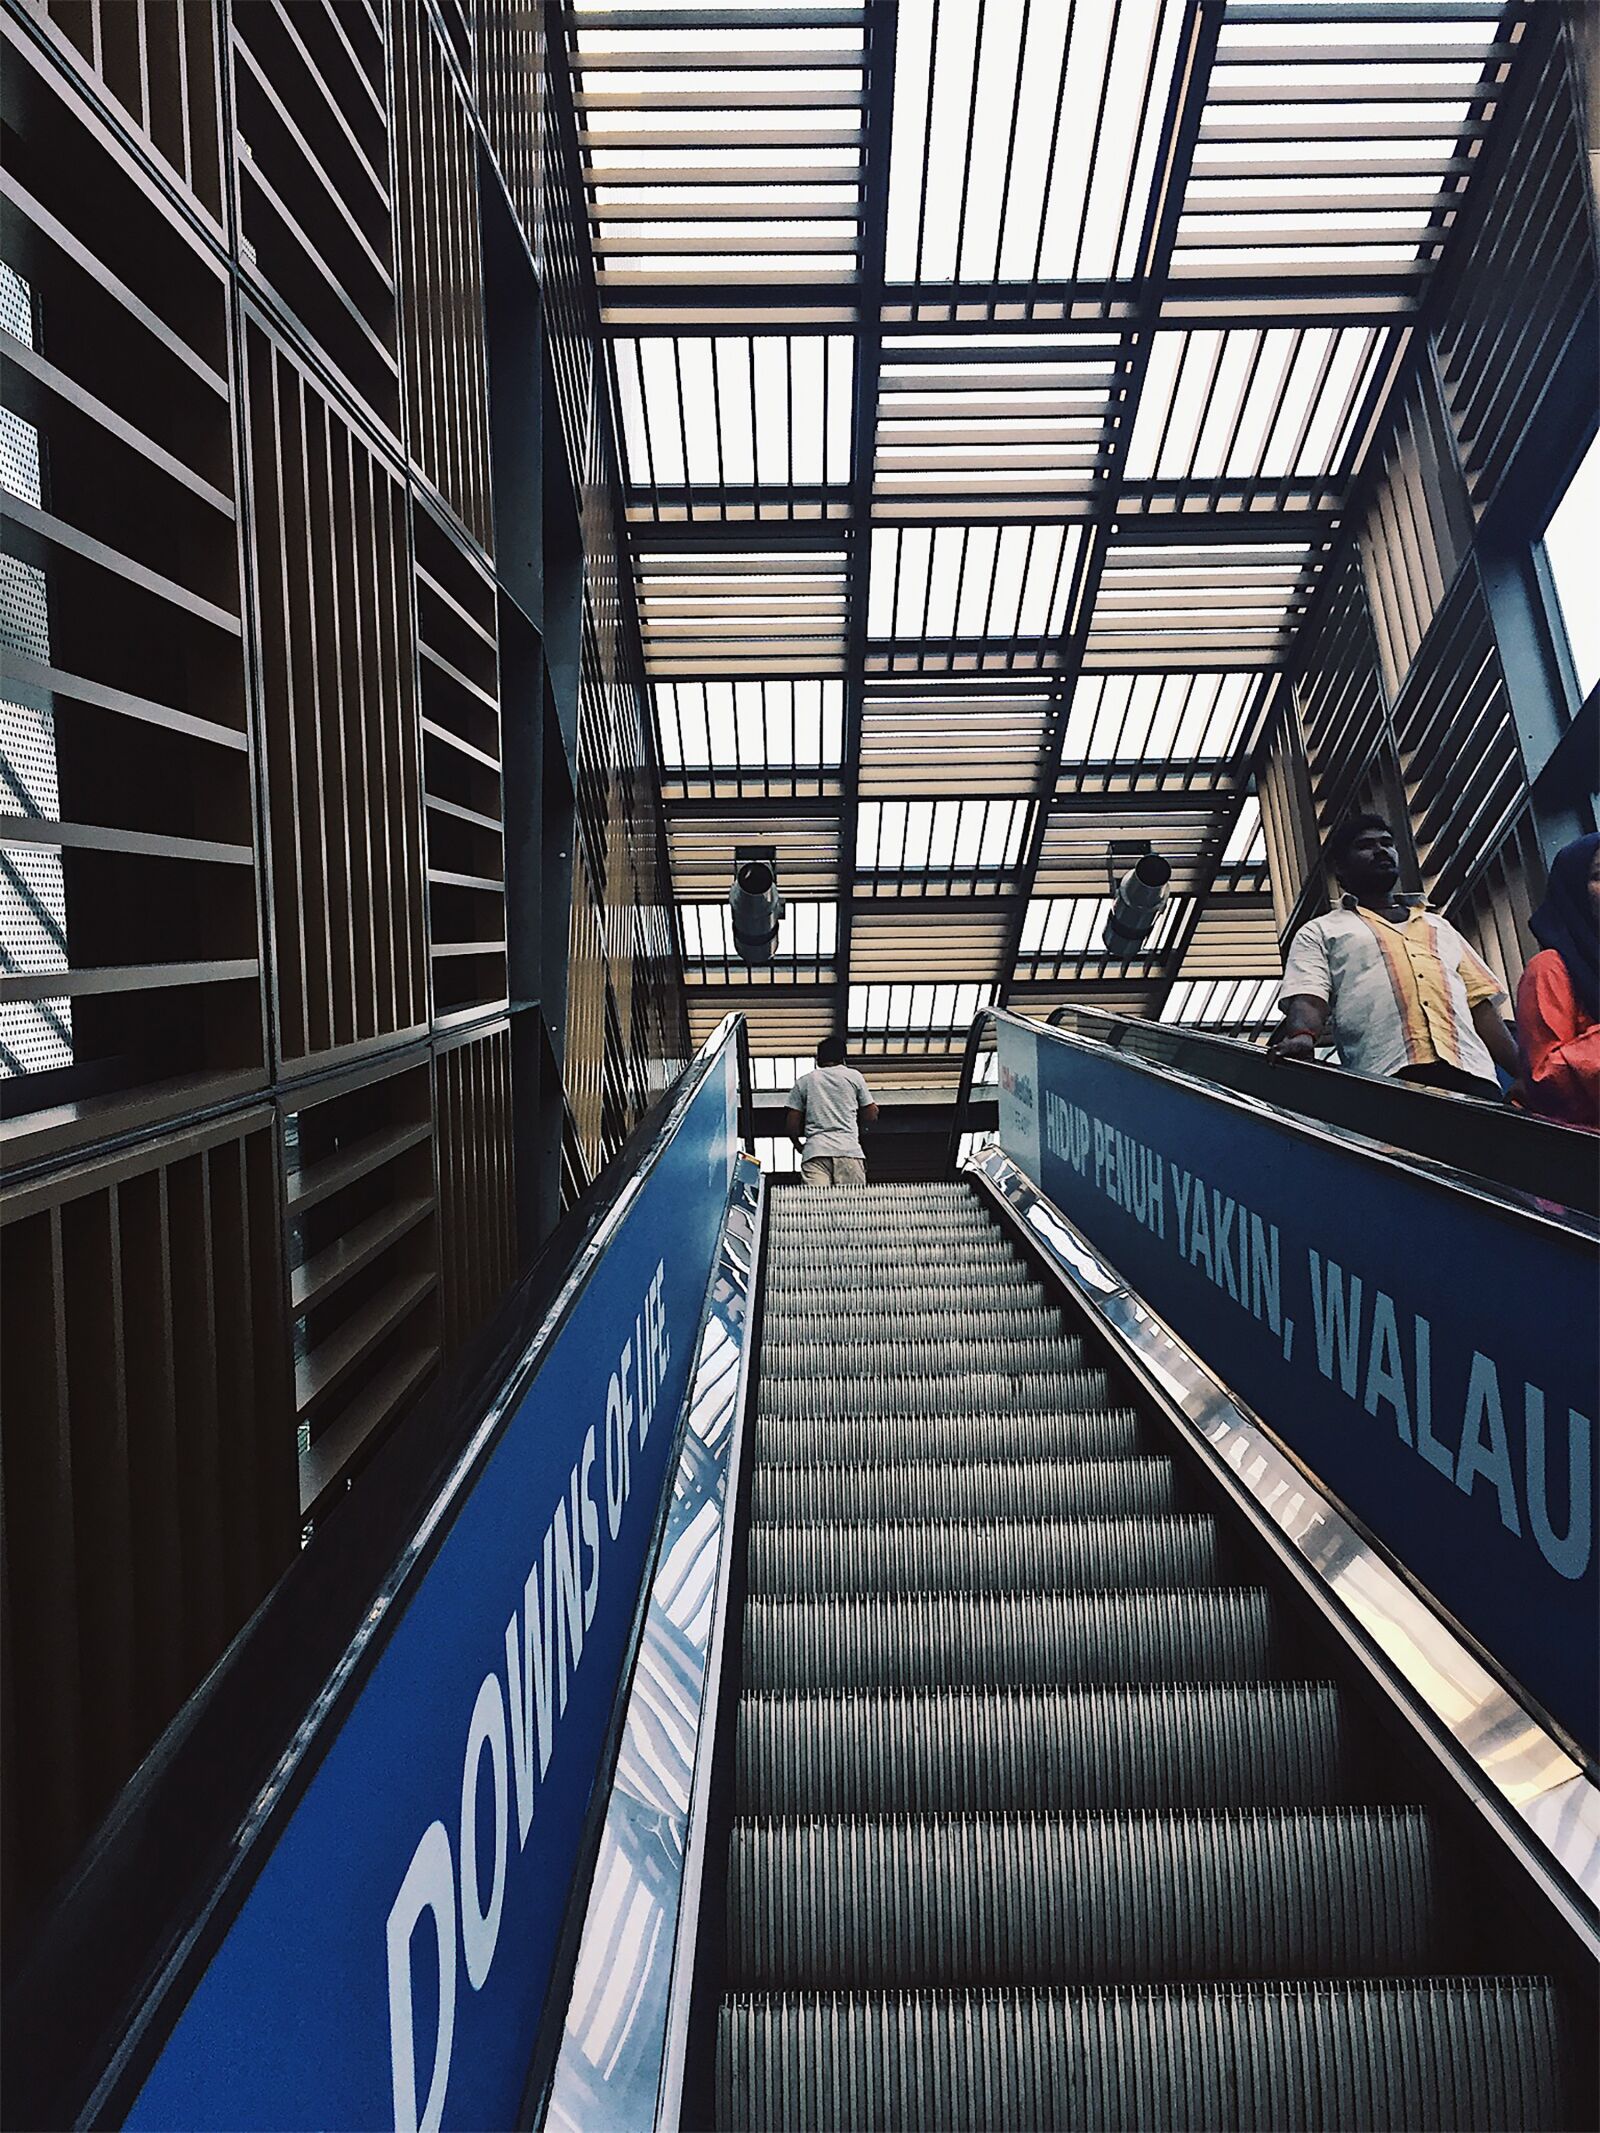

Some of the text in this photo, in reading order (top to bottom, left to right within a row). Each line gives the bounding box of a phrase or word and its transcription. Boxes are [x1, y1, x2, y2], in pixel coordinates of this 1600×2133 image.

[1045, 1089, 1592, 1580] HIDUP PENUH YAKIN, WALAU
[386, 1424, 601, 2133] DOWNS
[605, 1337, 633, 1541] OF
